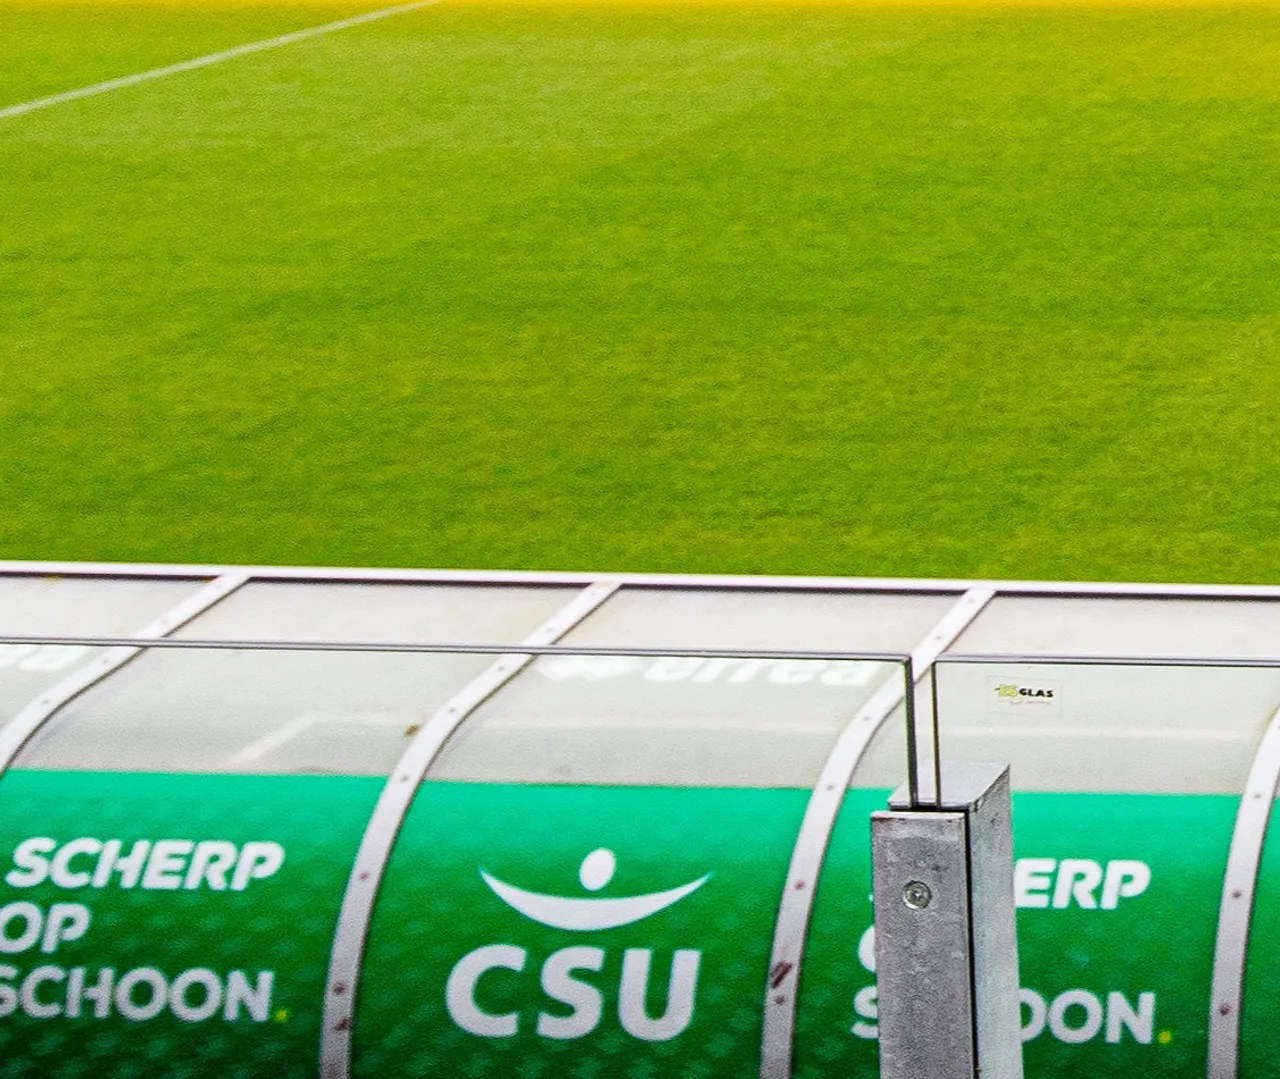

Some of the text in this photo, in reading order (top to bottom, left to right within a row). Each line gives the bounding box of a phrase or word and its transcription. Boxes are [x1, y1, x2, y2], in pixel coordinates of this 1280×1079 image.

[5, 836, 285, 891] SCHERP
[1012, 857, 1151, 910] ERP
[0, 901, 92, 953] OP
[446, 945, 702, 1042] CSU
